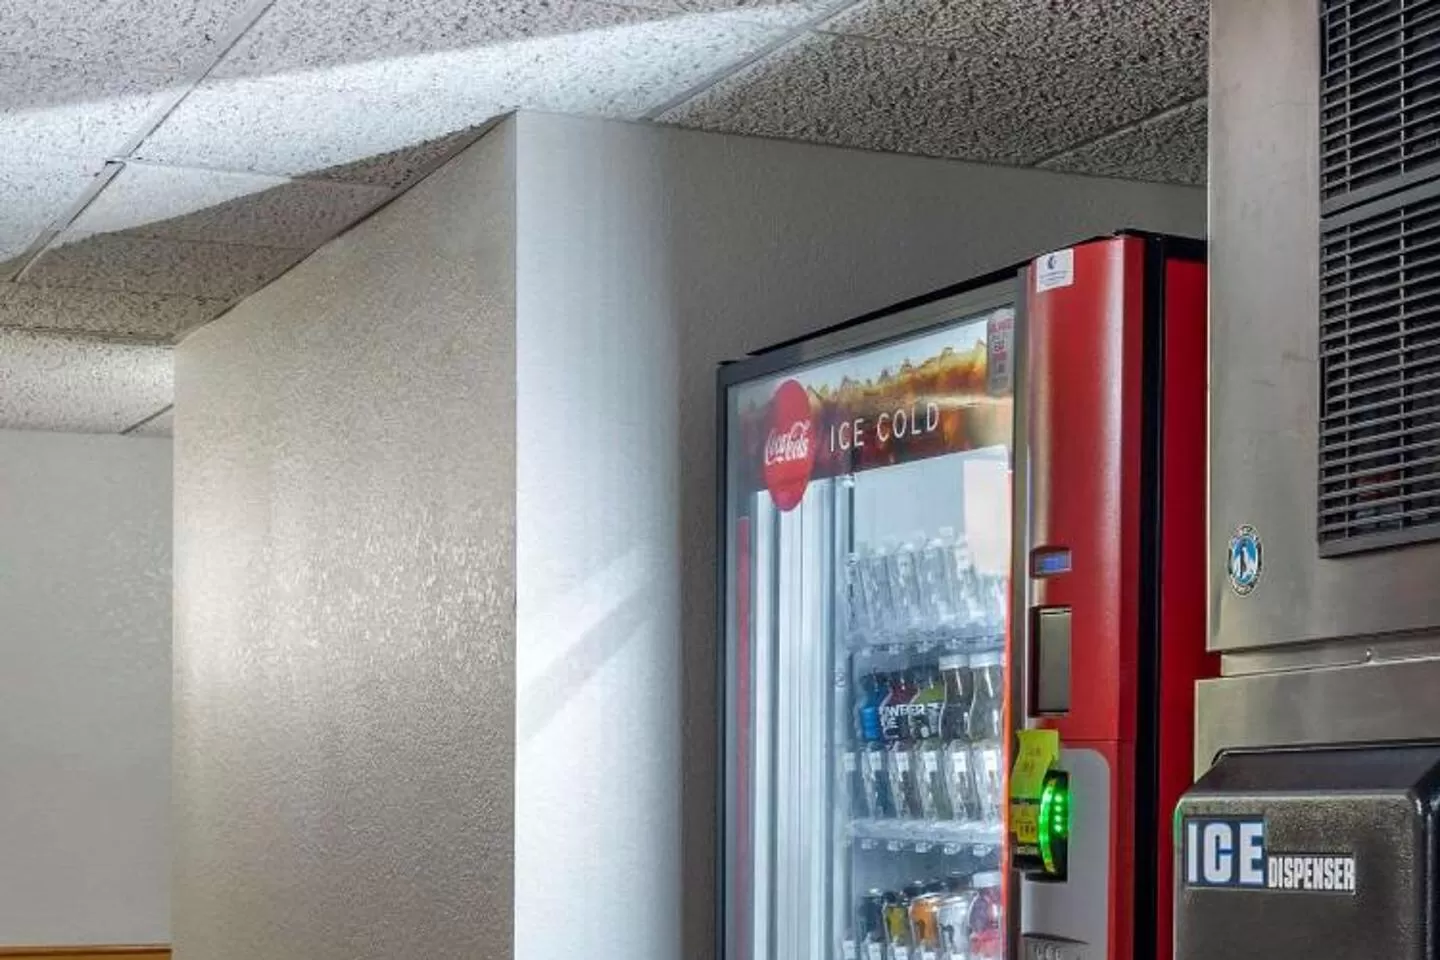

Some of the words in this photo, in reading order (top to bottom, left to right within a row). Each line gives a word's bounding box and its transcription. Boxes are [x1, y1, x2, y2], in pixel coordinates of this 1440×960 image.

[830, 418, 865, 452] ICE
[876, 402, 940, 443] COLD
[1187, 821, 1264, 884] ICE
[1268, 856, 1356, 891] DISPENSER
